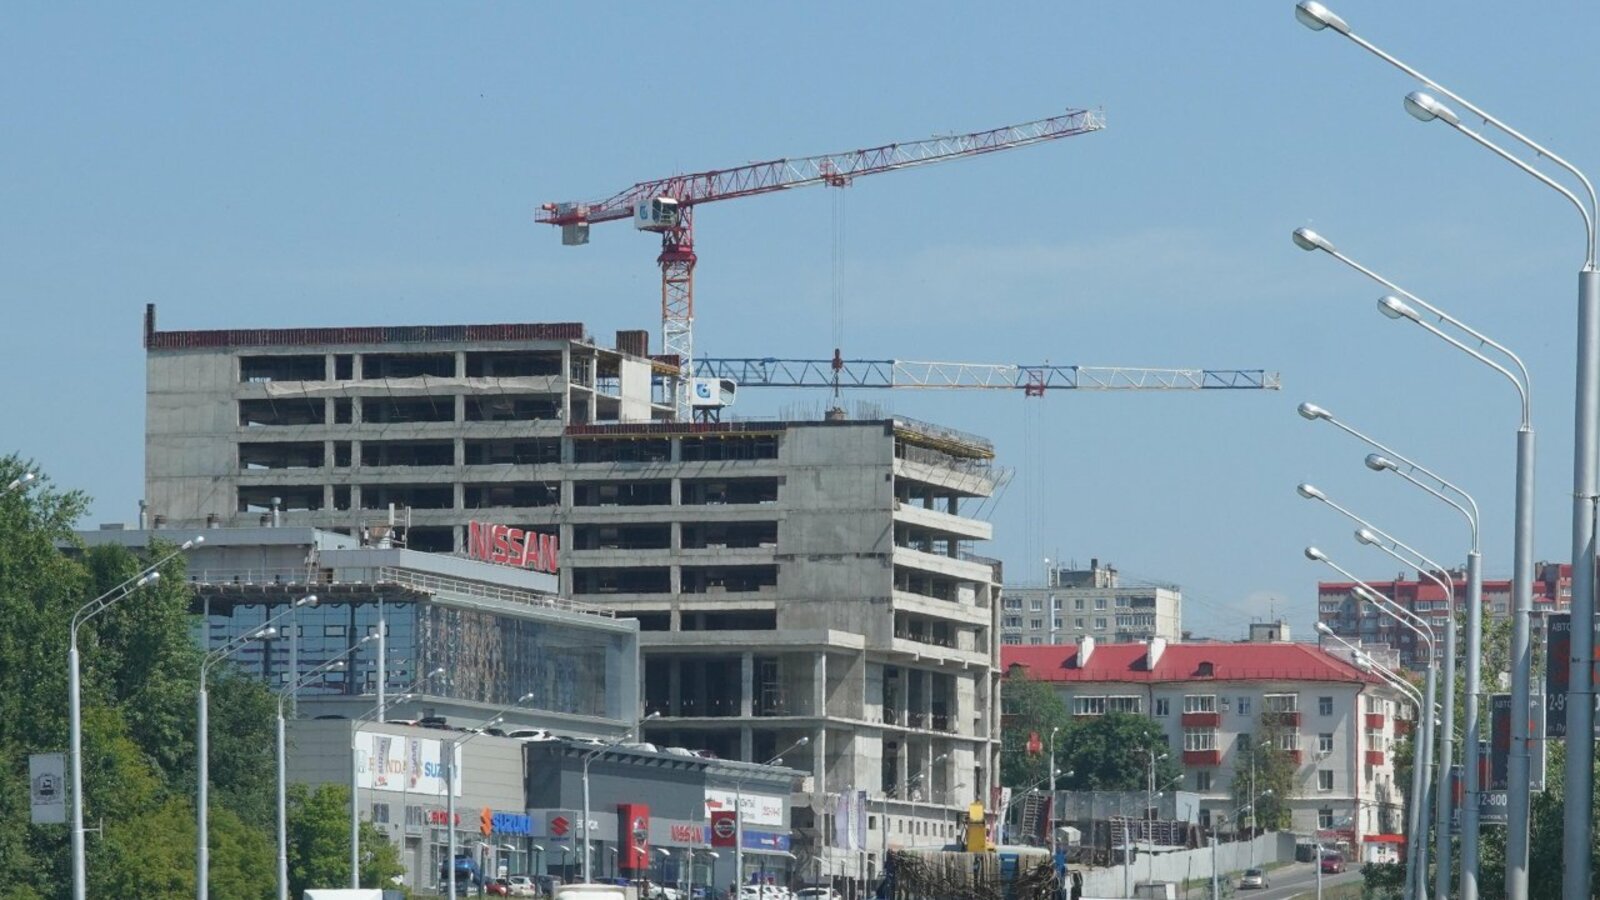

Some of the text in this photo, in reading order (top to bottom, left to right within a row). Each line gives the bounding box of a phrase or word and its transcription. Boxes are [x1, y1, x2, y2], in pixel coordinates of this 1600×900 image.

[468, 520, 558, 573] NISSAN
[493, 813, 532, 834] SUZUKI
[671, 824, 703, 843] NISSAN
